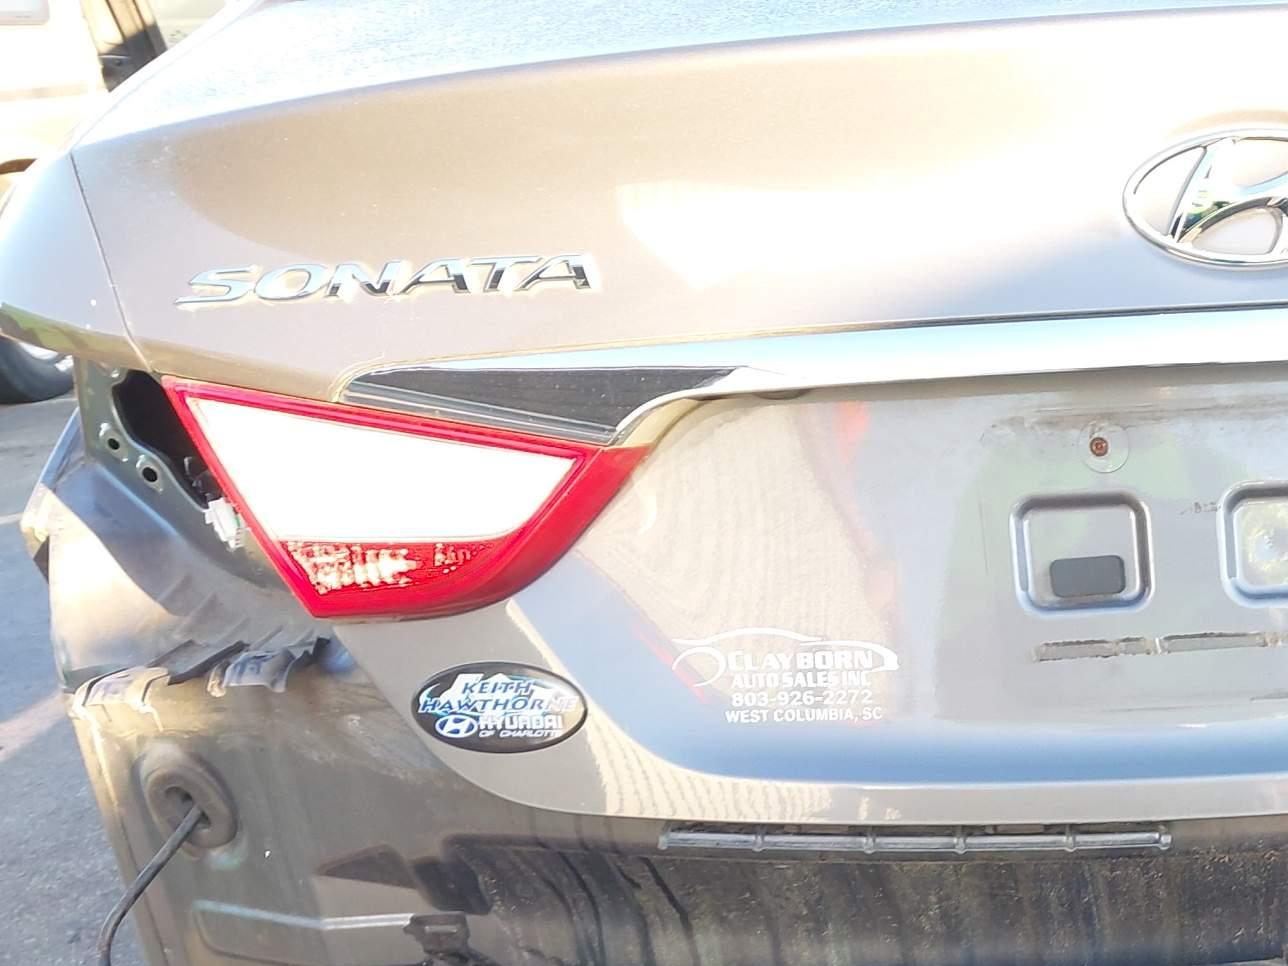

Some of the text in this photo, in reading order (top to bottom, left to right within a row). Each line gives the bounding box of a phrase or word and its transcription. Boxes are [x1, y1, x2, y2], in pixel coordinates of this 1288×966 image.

[175, 254, 592, 304] SONATA
[727, 650, 873, 671] CLAYBORN
[462, 681, 534, 695] KEITH
[731, 671, 779, 689] AUTO
[782, 670, 834, 688] SALES
[420, 697, 578, 712] HAWTHORNE
[731, 689, 873, 708] 803-926-2272
[479, 715, 563, 730] HYUNDAI
[725, 706, 883, 723] WEST COLUMBIA, SC
[479, 730, 496, 738] OF
